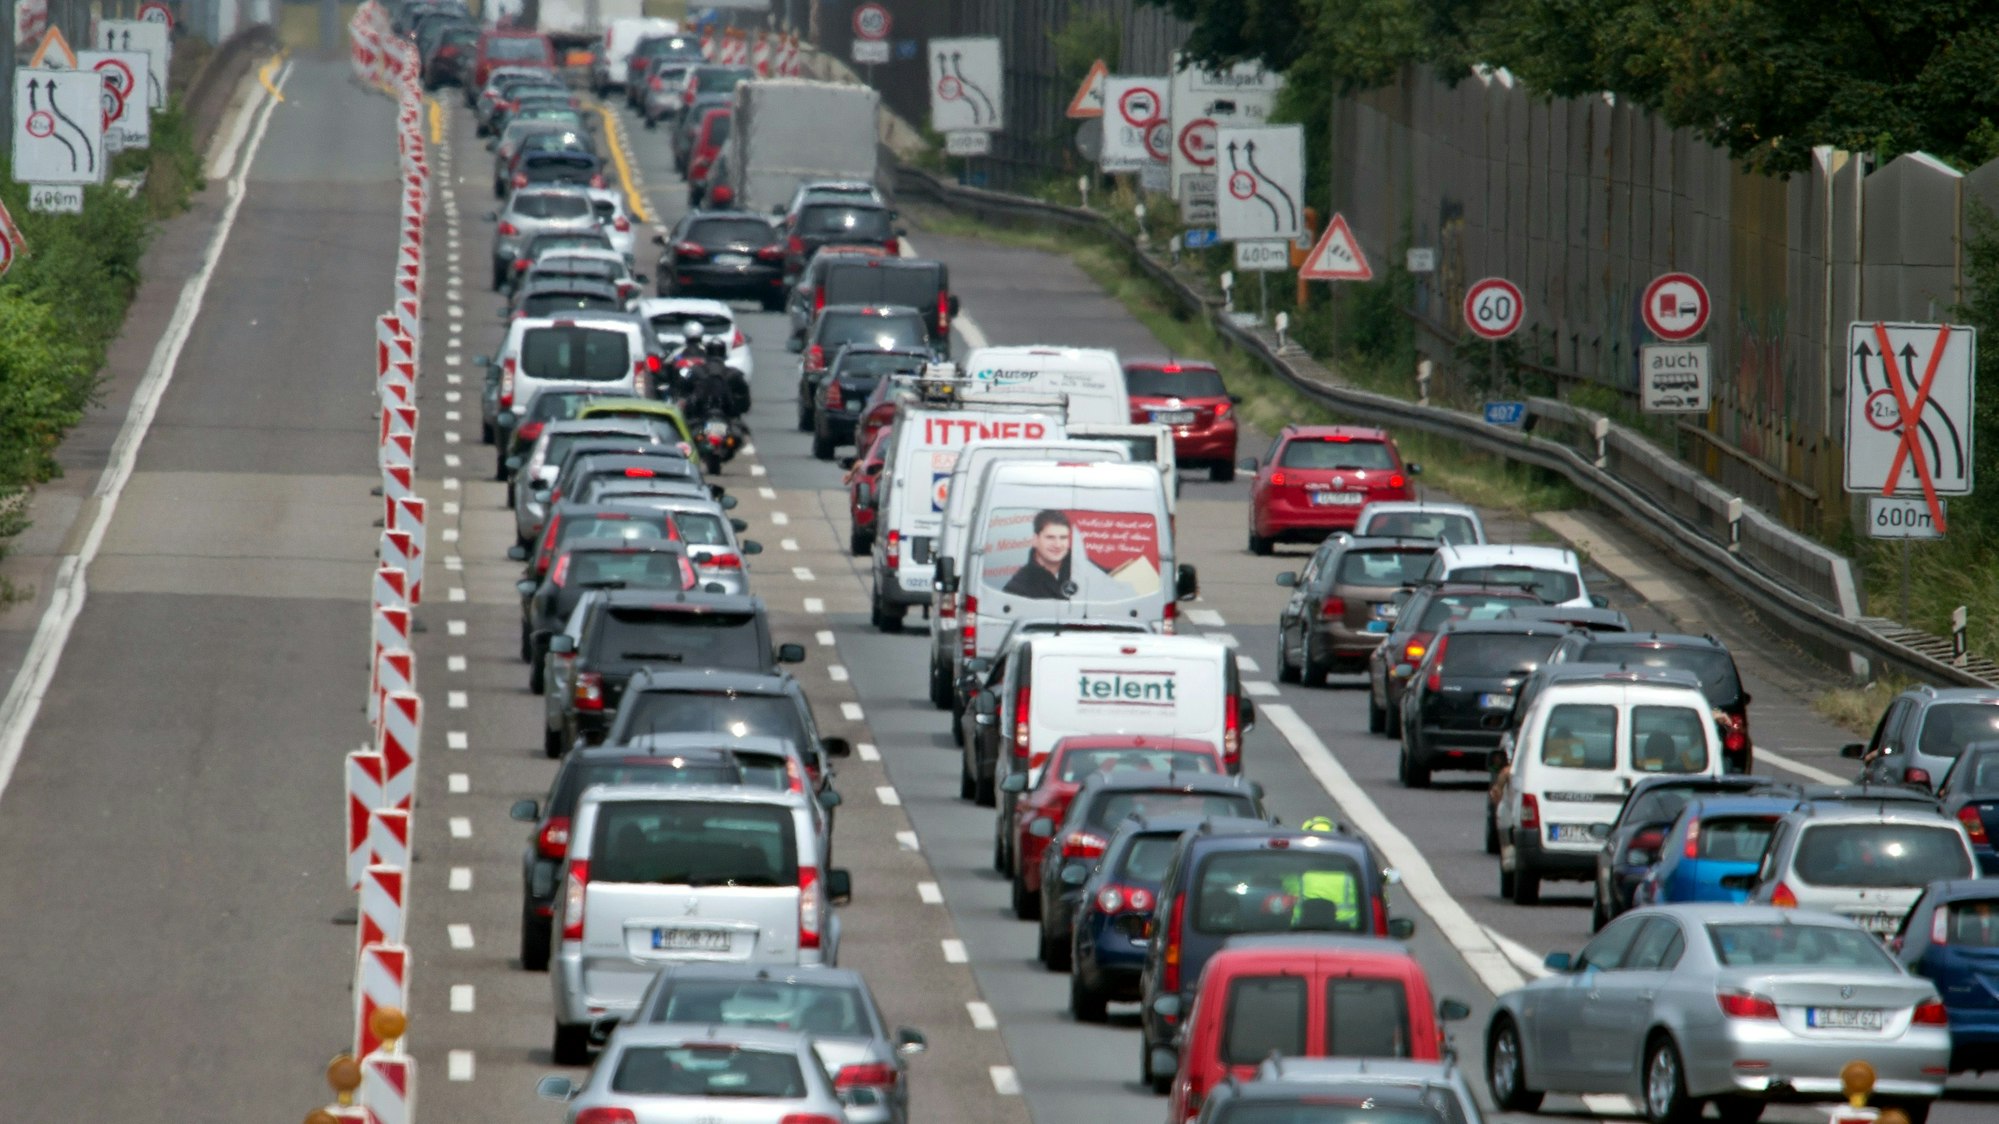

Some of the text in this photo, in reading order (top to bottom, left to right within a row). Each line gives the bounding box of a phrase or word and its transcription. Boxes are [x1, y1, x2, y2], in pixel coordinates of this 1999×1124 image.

[1242, 248, 1285, 262] 400m
[1479, 296, 1511, 322] 60
[1652, 351, 1699, 370] auch
[1079, 676, 1175, 700] telent
